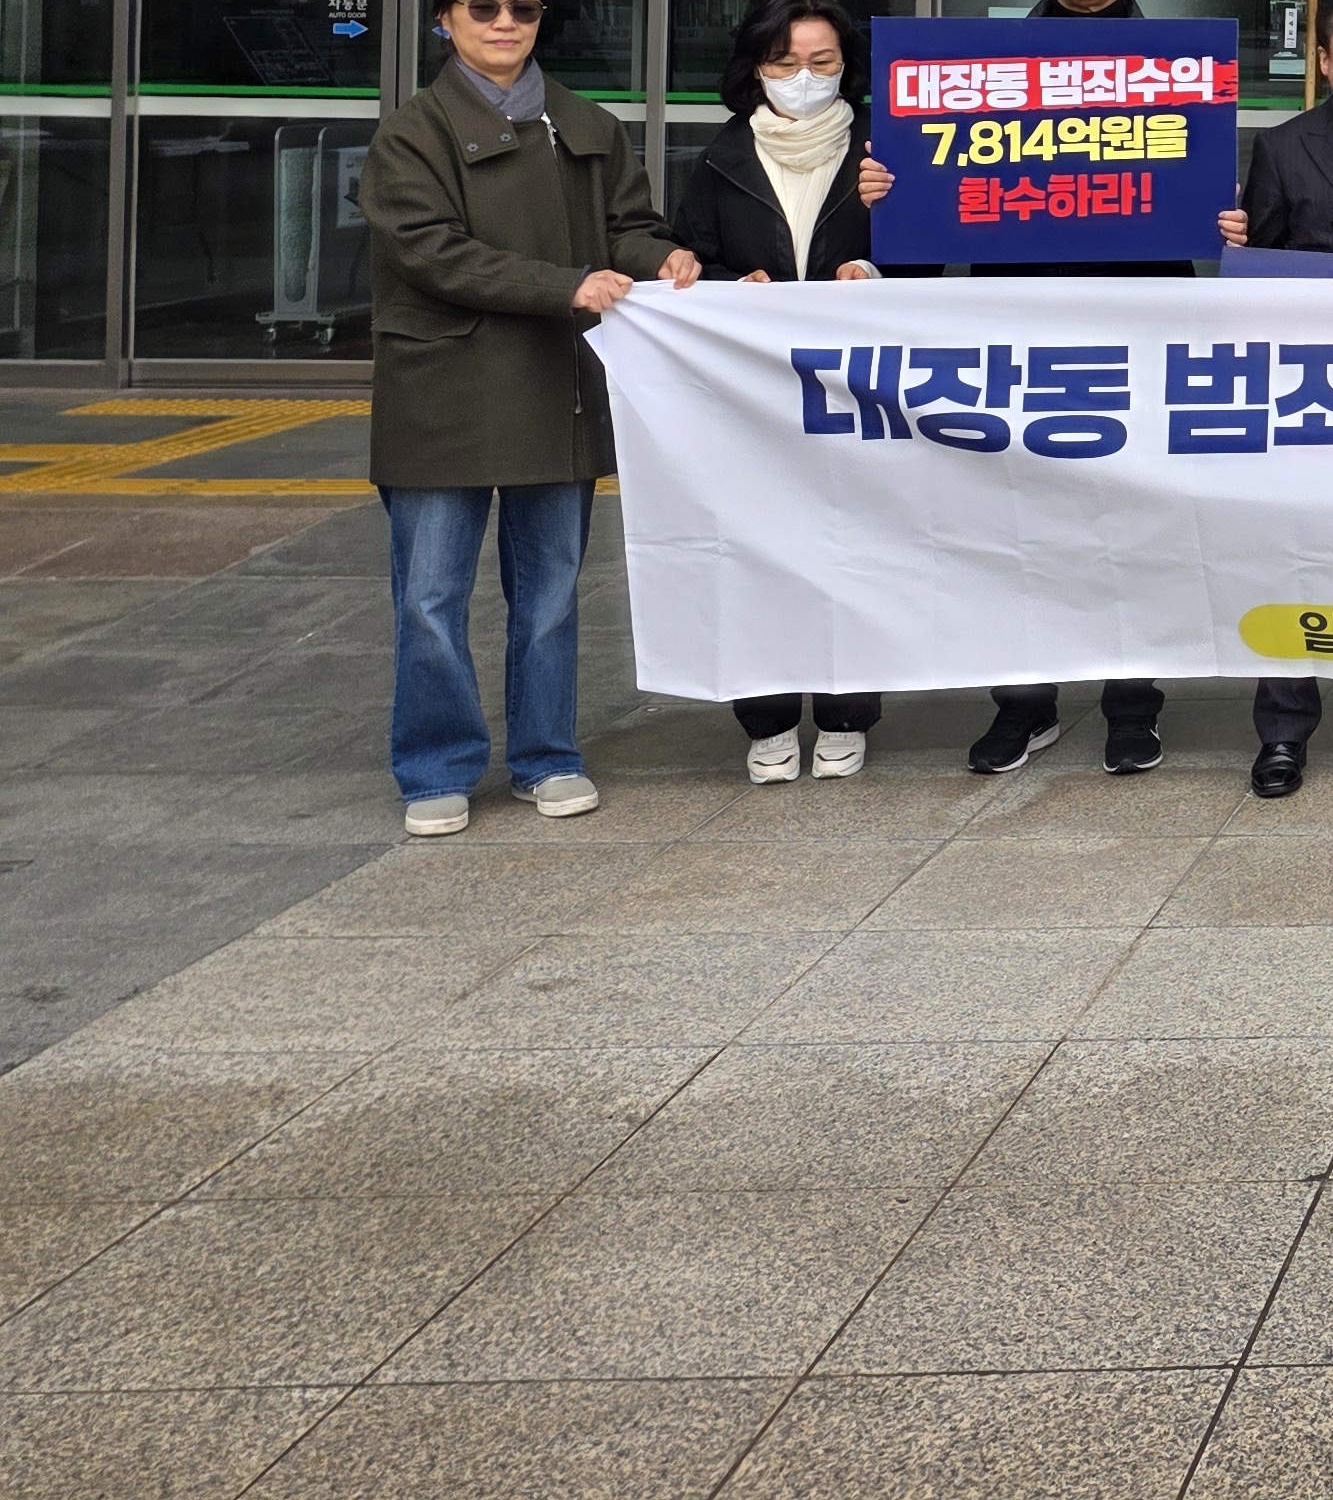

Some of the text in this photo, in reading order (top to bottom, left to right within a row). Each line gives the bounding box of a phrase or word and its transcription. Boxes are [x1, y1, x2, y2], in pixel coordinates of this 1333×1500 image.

[895, 56, 1214, 110] 대장동 범죄수익
[921, 114, 1189, 167] 7,814억원을
[958, 172, 1153, 223] 환수하라!
[790, 342, 1132, 459] 대장동
